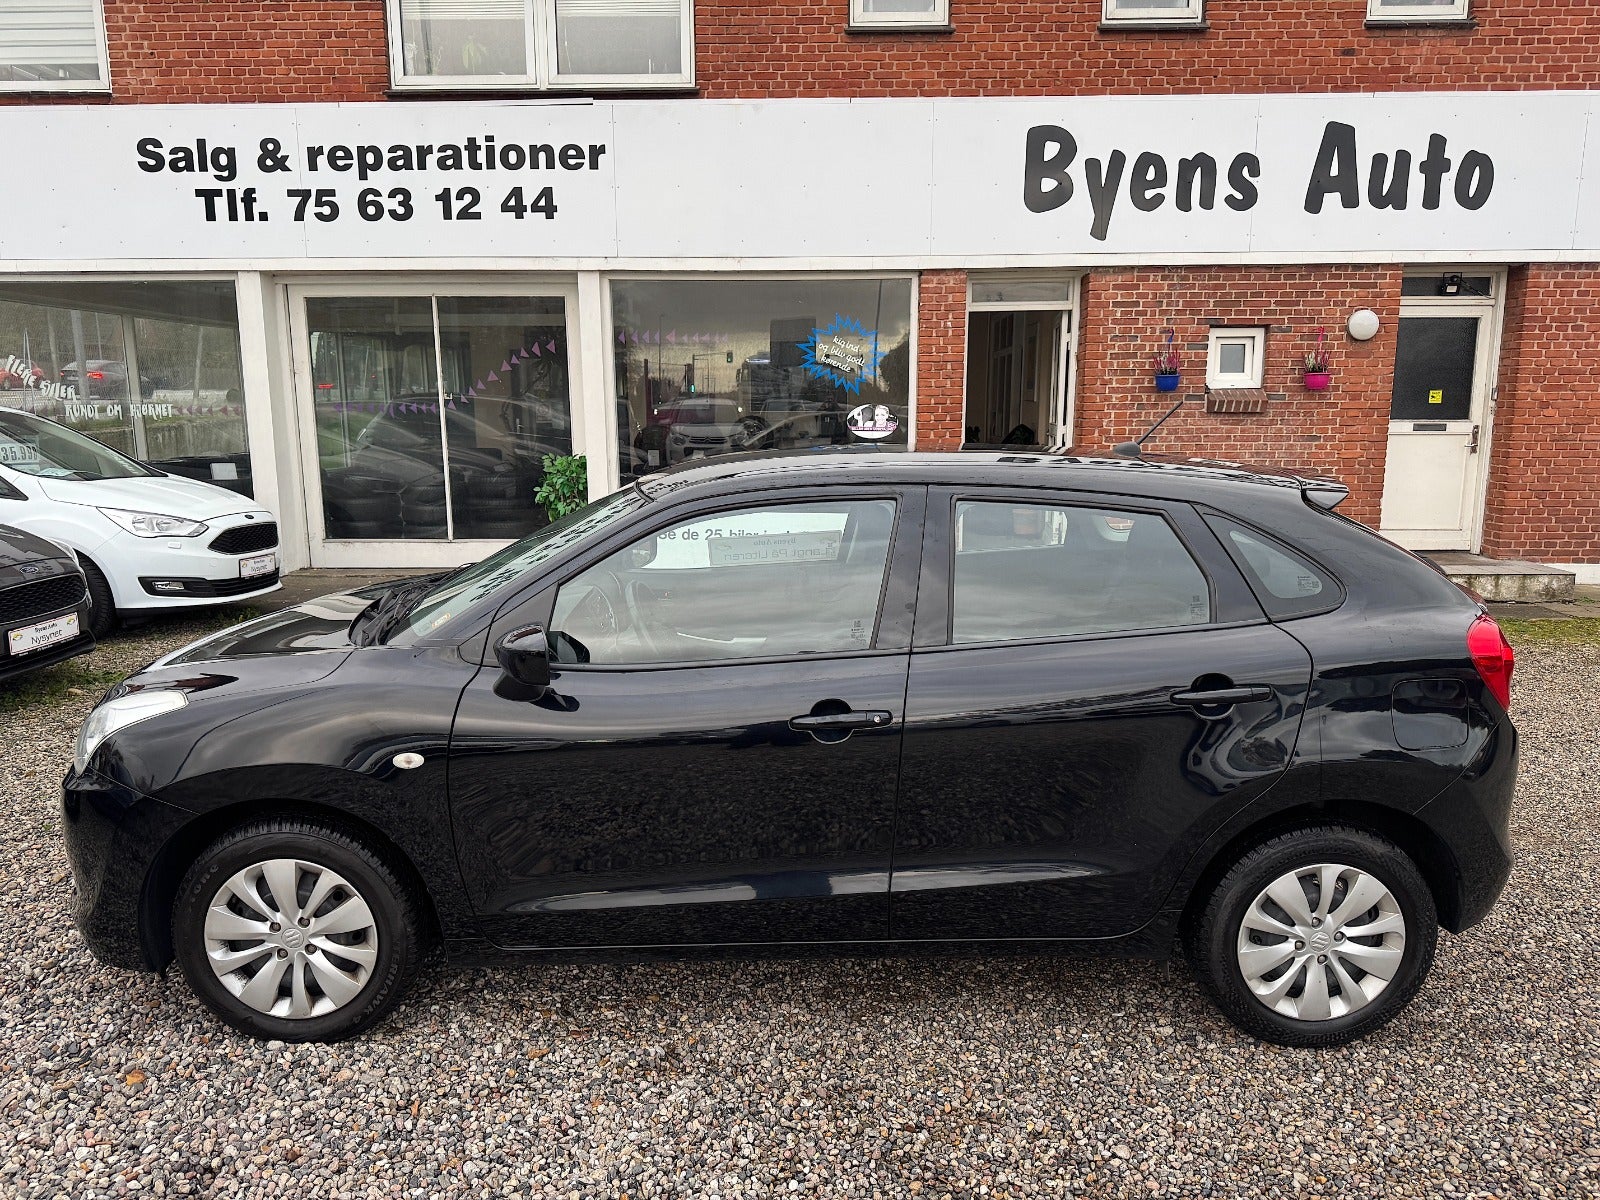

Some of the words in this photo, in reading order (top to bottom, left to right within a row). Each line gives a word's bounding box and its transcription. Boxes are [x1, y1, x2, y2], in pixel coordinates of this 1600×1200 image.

[137, 138, 237, 182] Salg
[257, 138, 292, 173] &
[307, 135, 605, 180] reparationer
[1024, 125, 1260, 241] Byens
[1304, 121, 1494, 214] Auto
[195, 188, 268, 221] Tlf.
[287, 189, 339, 222] 75
[358, 188, 413, 221] 63
[435, 187, 481, 220] 12
[501, 187, 557, 219] 44
[818, 343, 829, 353] og
[830, 346, 846, 358] bliv
[845, 354, 865, 367] godt
[64, 403, 100, 423] RUNDT
[106, 404, 123, 420] OM
[129, 403, 173, 421] HJØRNET
[681, 528, 699, 541] de
[704, 528, 723, 541] 25
